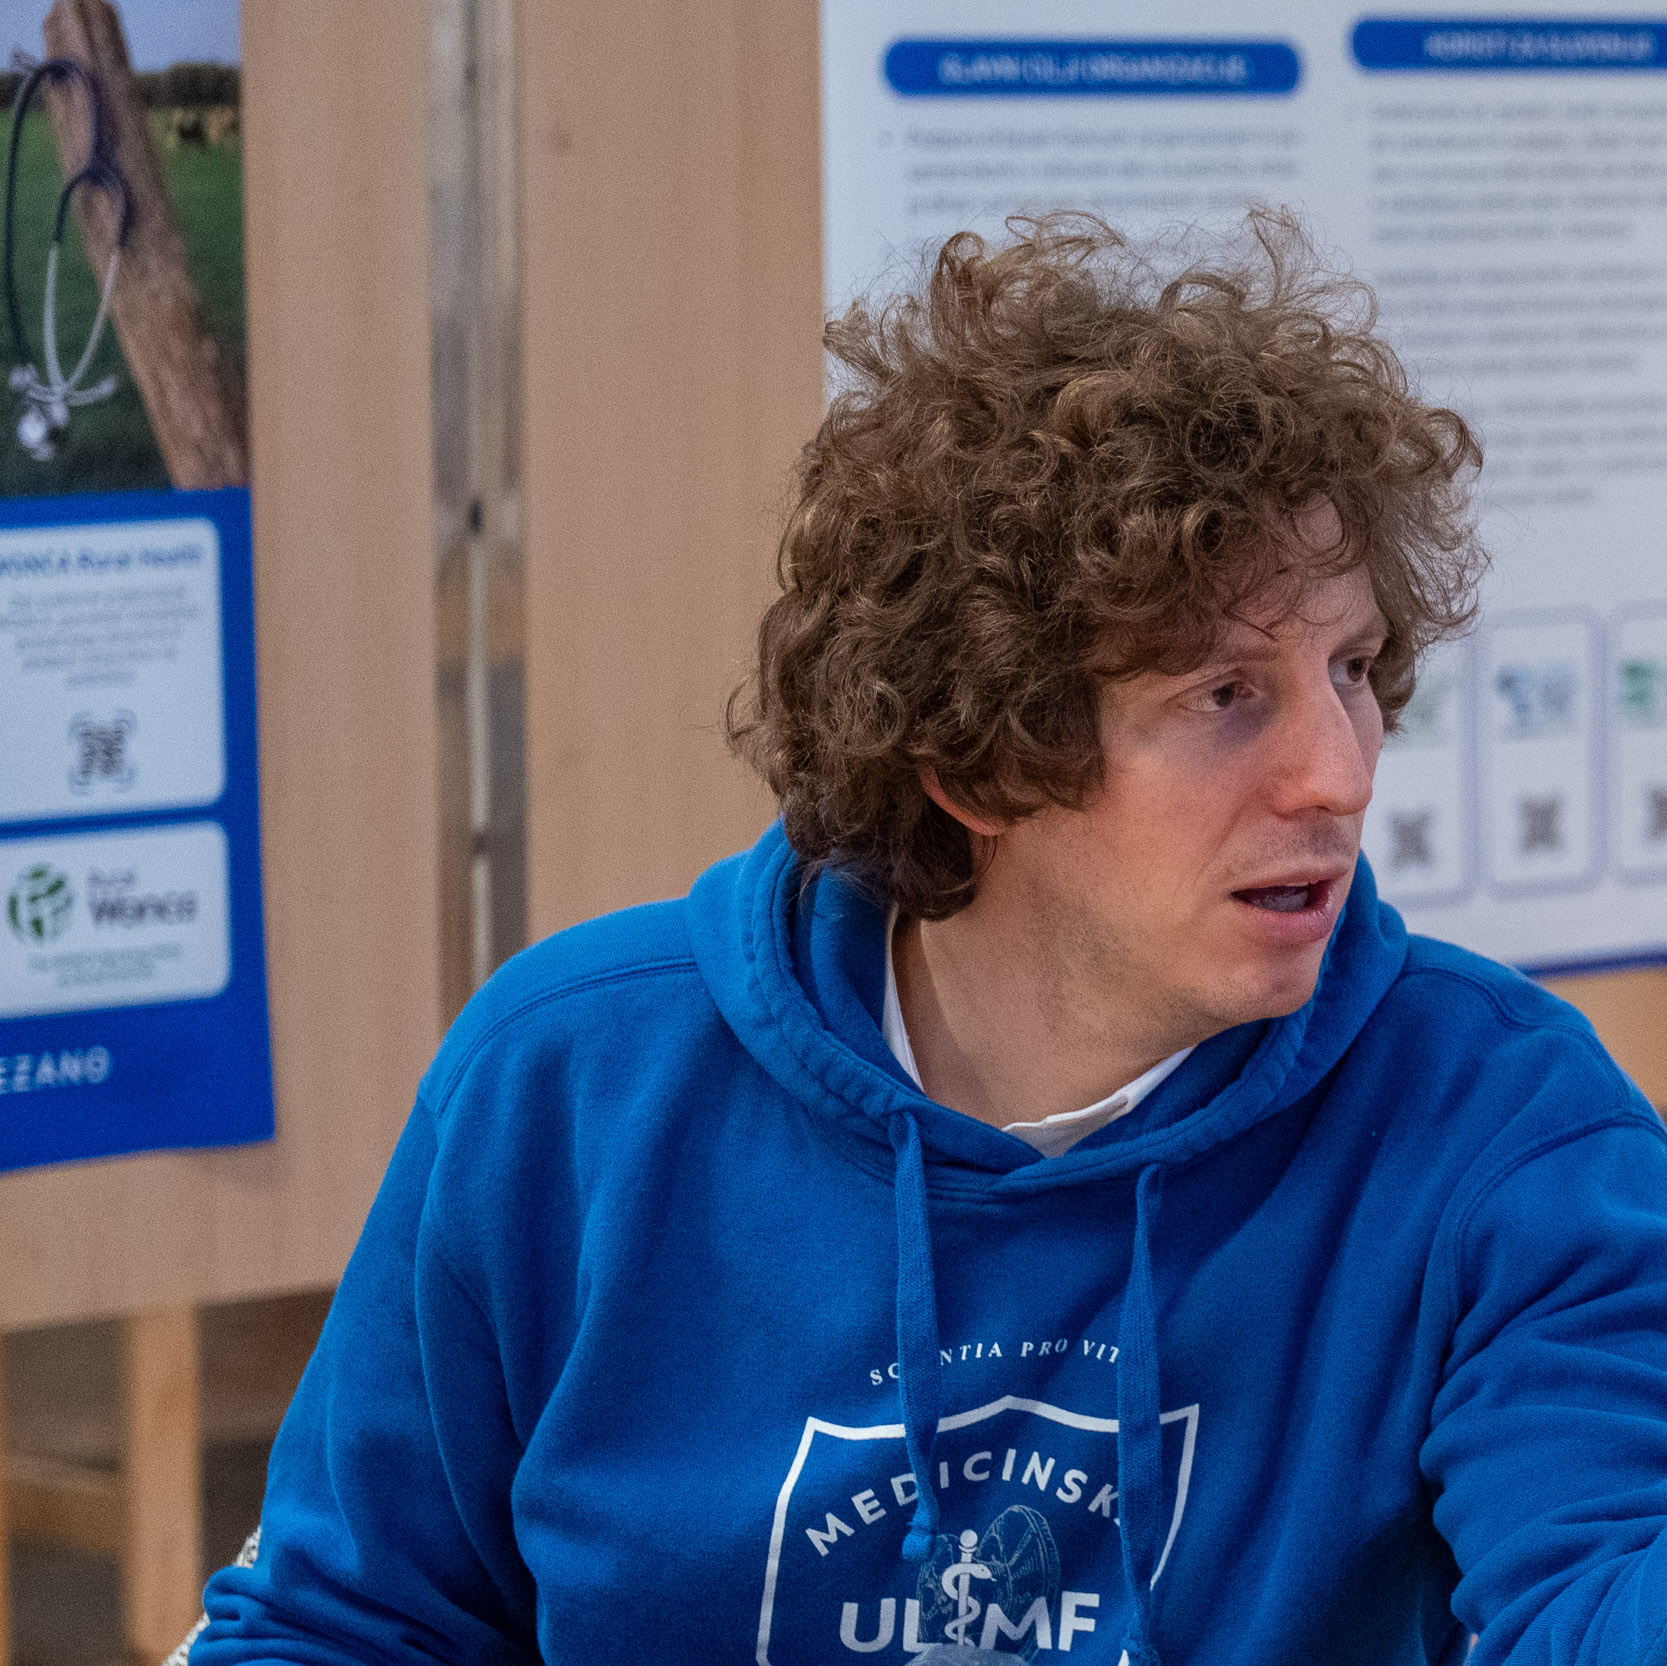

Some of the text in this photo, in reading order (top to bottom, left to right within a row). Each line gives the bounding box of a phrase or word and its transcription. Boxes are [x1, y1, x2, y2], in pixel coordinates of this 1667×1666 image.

[869, 1338, 1120, 1386] SCNTIA PRO VIT
[805, 1448, 1121, 1557] MEDICINSK
